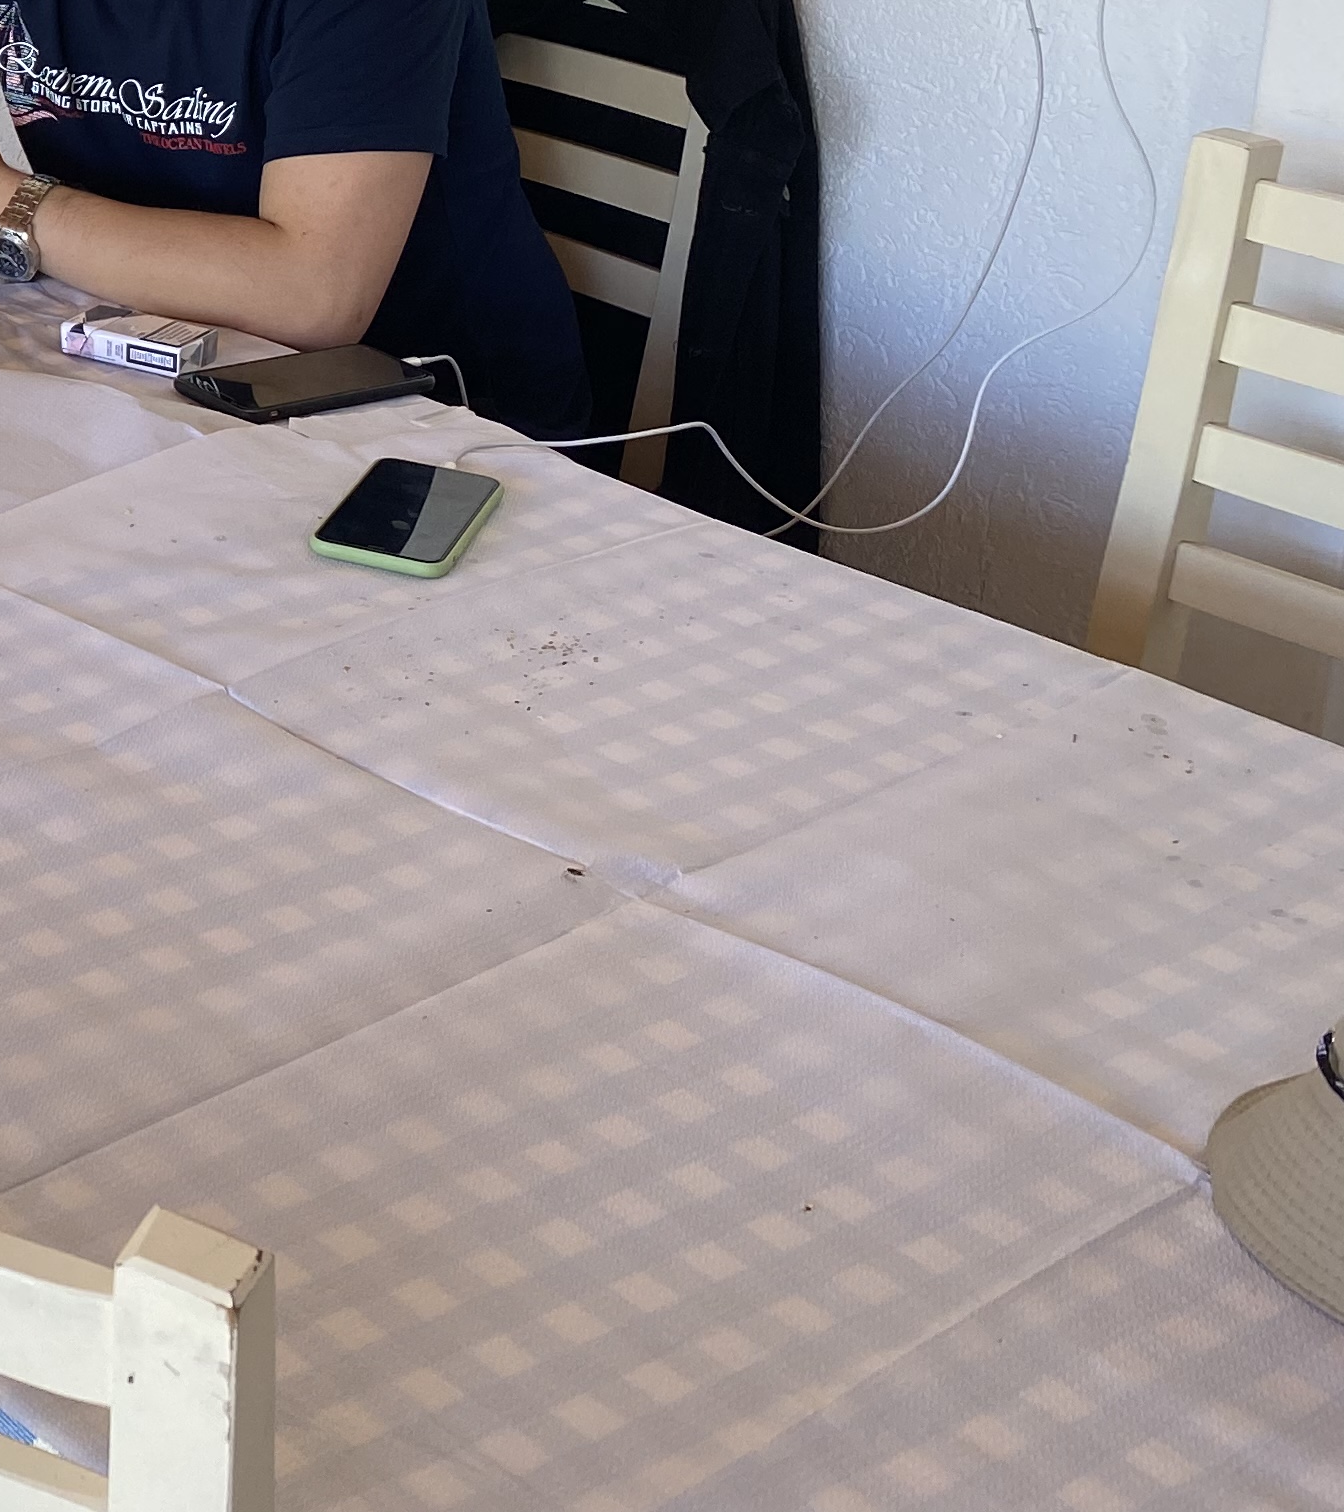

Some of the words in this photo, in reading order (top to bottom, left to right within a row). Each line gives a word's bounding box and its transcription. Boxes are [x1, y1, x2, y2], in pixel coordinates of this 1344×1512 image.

[75, 98, 122, 115] STORM
[135, 116, 203, 136] CAPTAINS
[119, 78, 238, 138] Sailing
